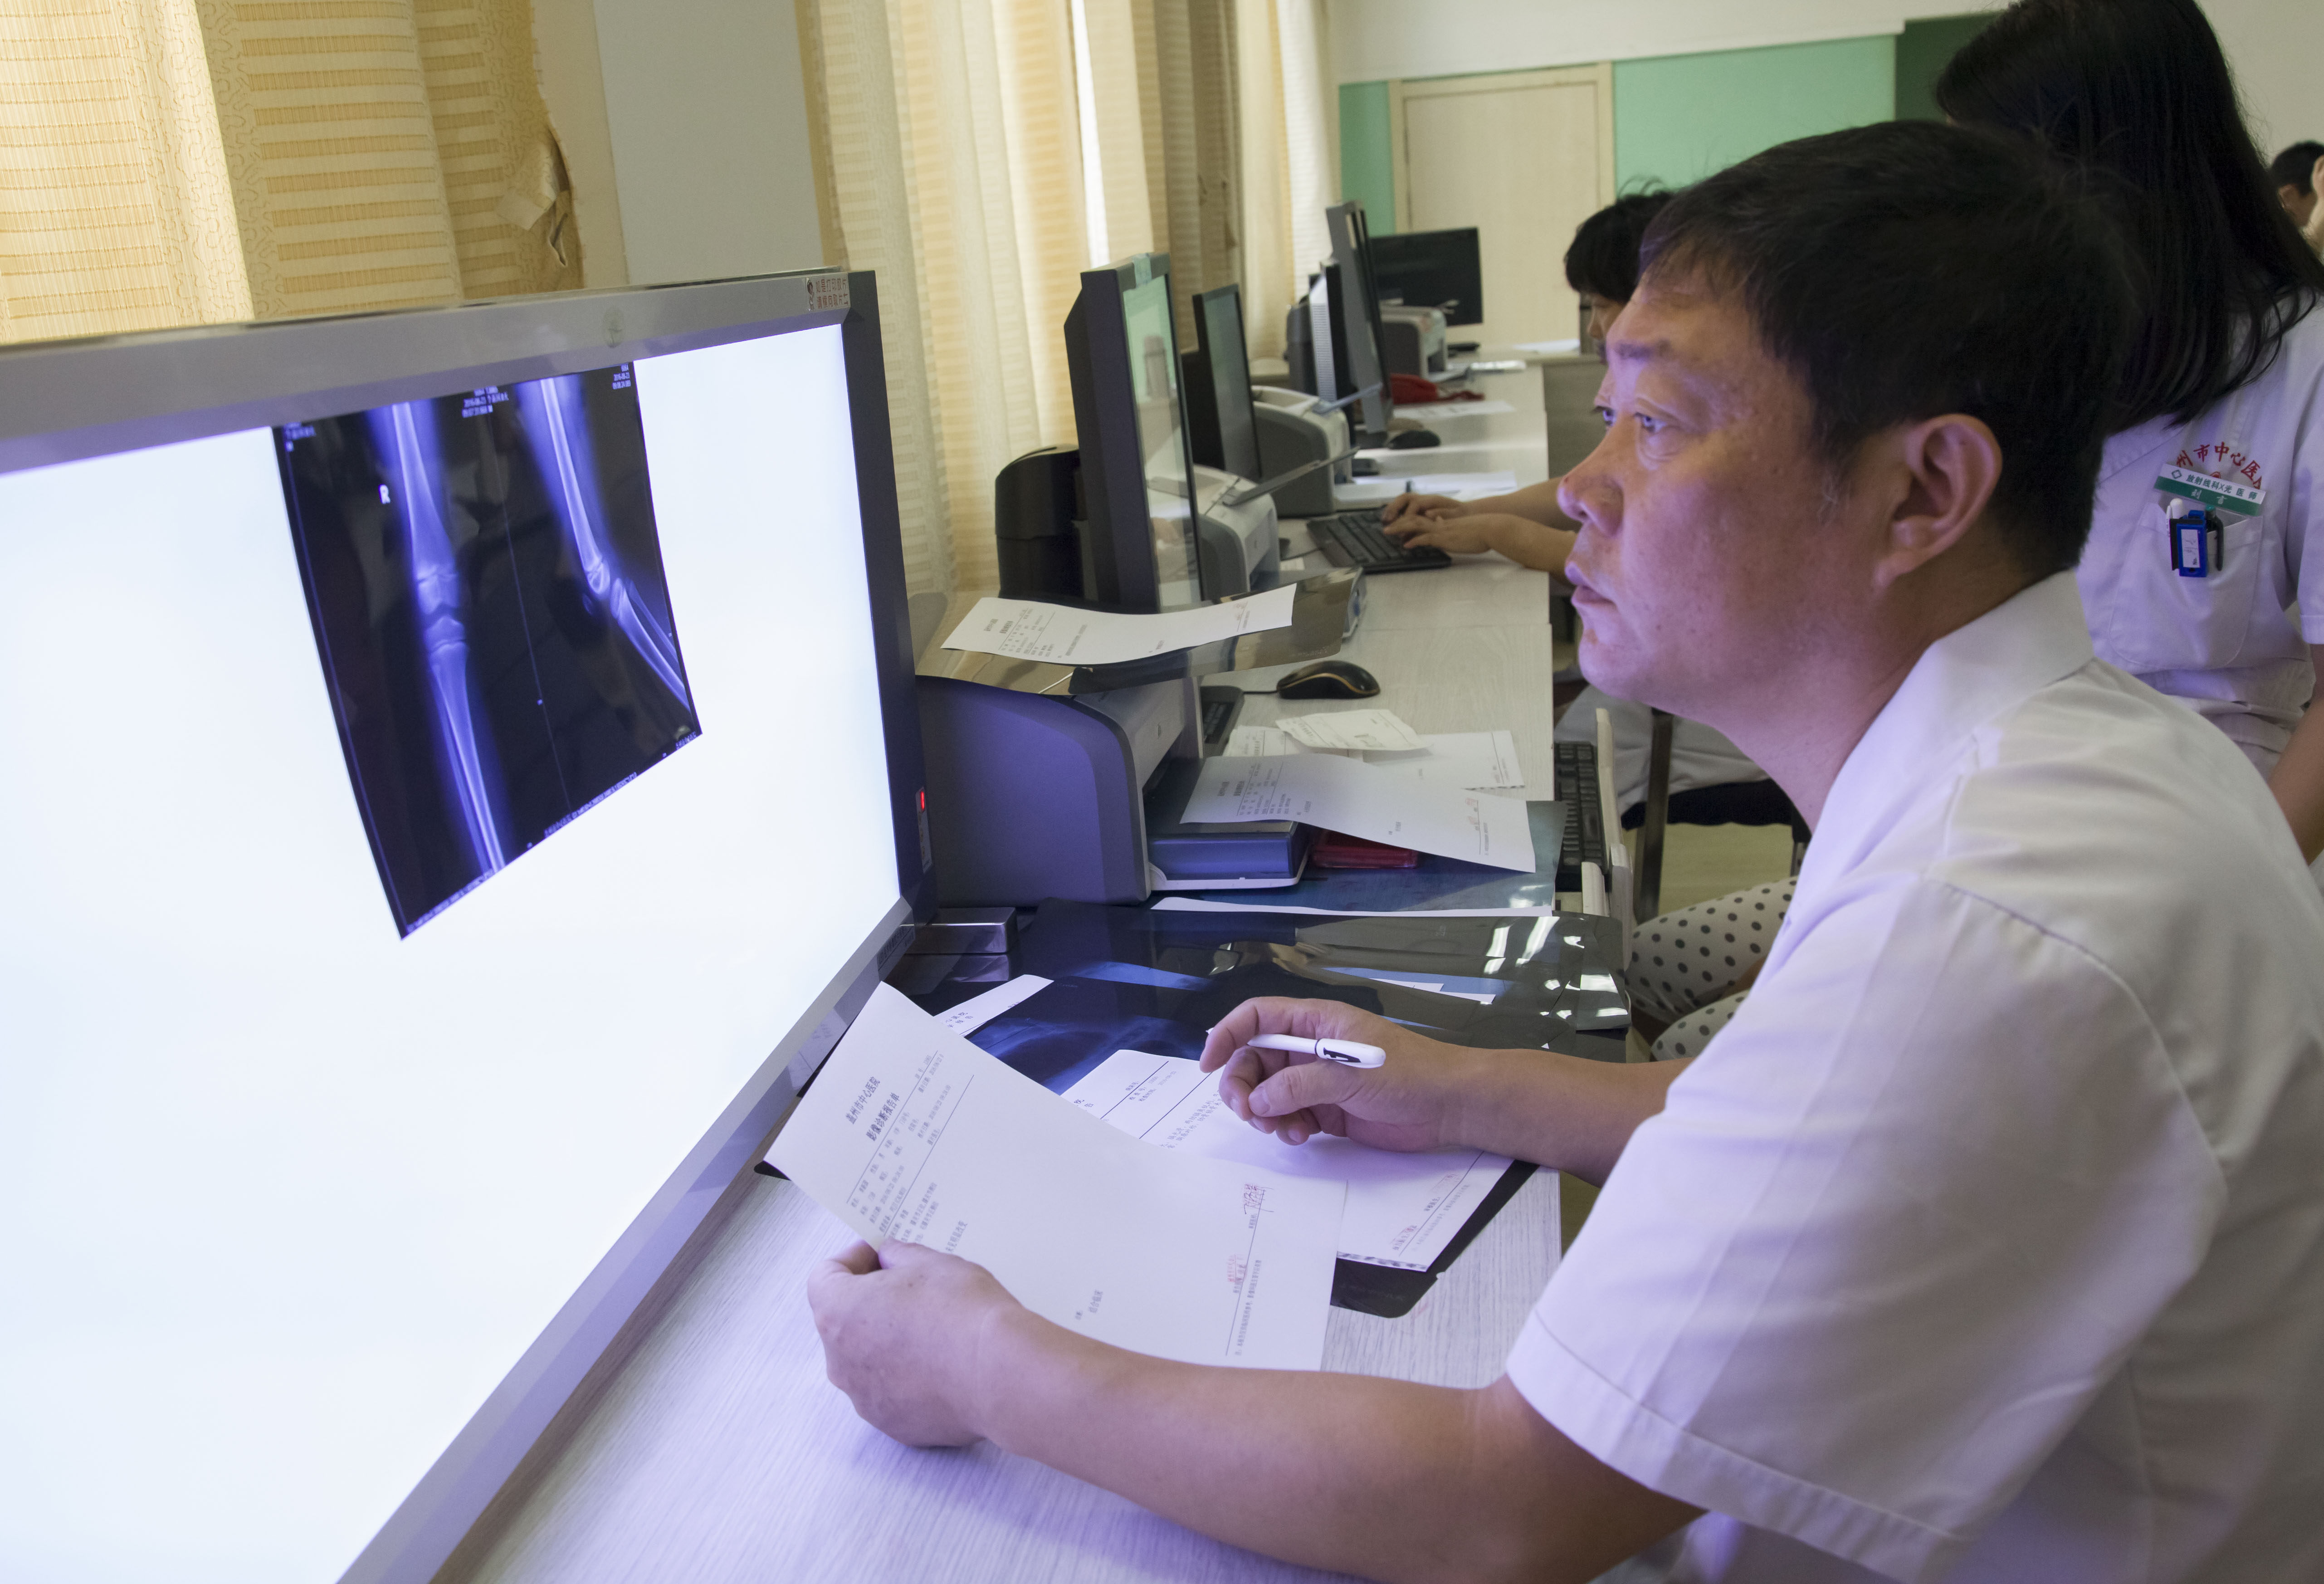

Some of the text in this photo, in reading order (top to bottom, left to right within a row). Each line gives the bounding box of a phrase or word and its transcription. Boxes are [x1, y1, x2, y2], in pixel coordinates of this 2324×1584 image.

[379, 484, 391, 504] R
[845, 1076, 880, 1124] 盖州市中心医院
[865, 1092, 899, 1141] 影像诊断报告单
